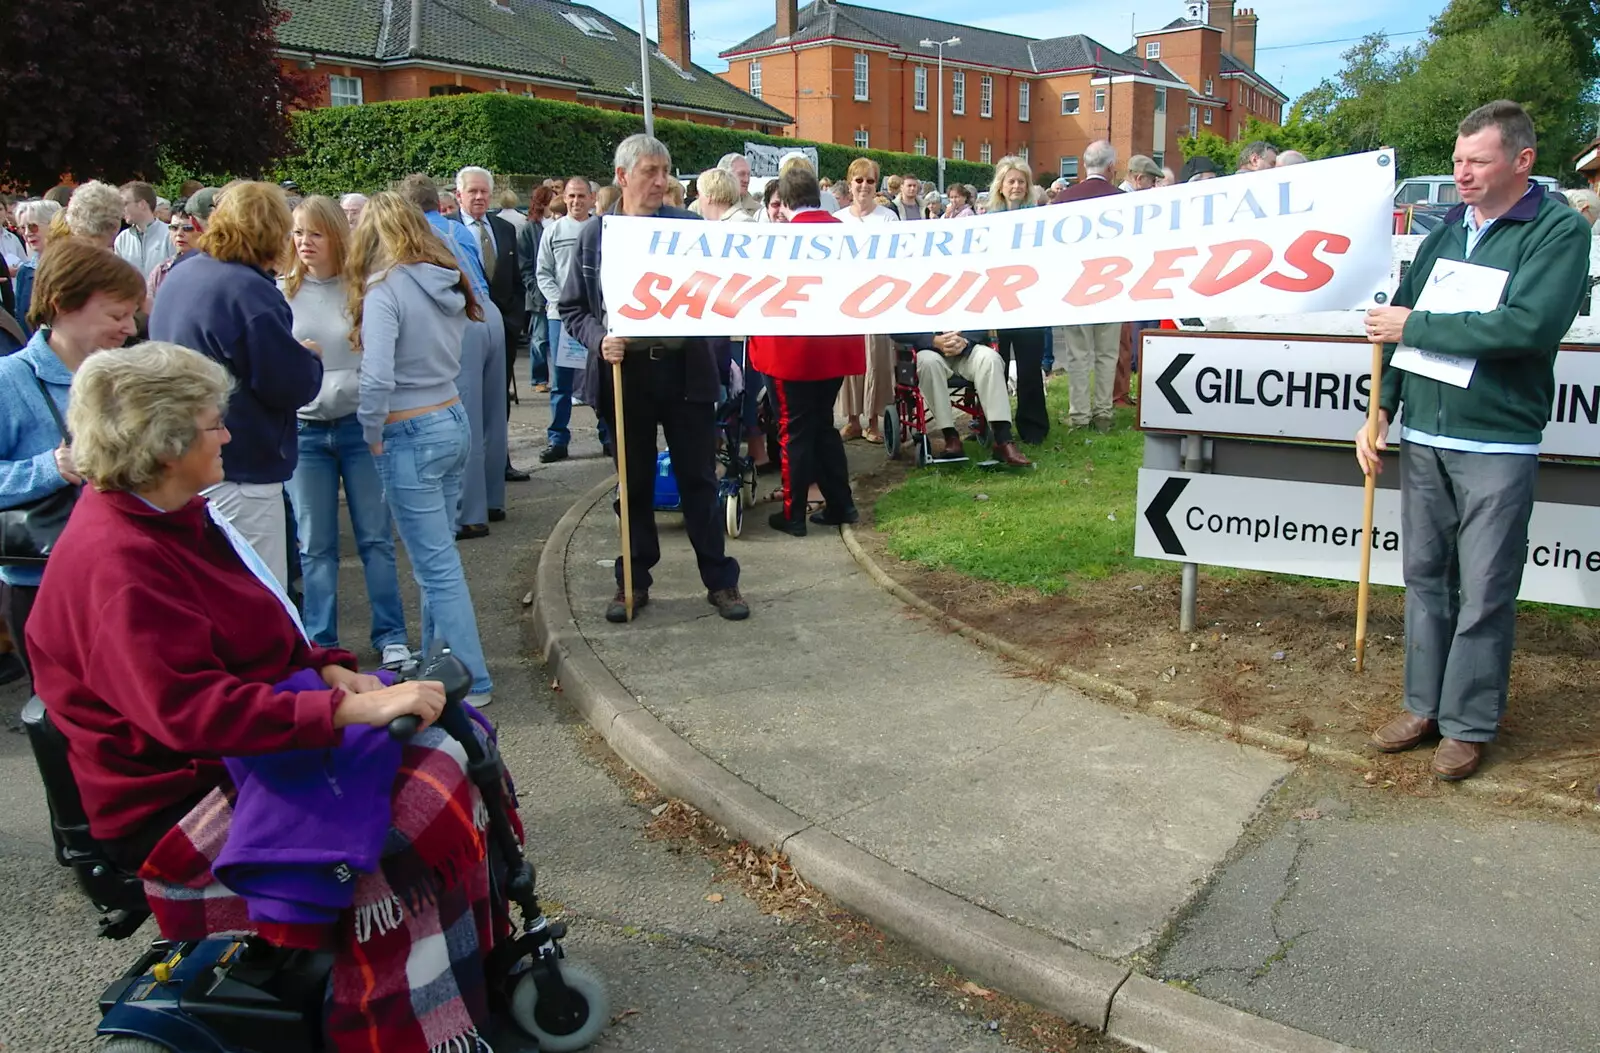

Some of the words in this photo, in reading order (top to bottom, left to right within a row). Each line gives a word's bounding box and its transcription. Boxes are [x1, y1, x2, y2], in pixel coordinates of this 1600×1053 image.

[649, 227, 990, 261] HARTISMERE
[1011, 181, 1314, 250] HOSPITAL
[618, 270, 823, 320] SAVE
[840, 265, 1039, 318] OUR
[1062, 230, 1351, 306] BEDS
[1195, 366, 1371, 413] GILCHRIS
[1547, 383, 1600, 425] IN
[1186, 506, 1399, 551] Complementa
[1524, 539, 1600, 572] icine
